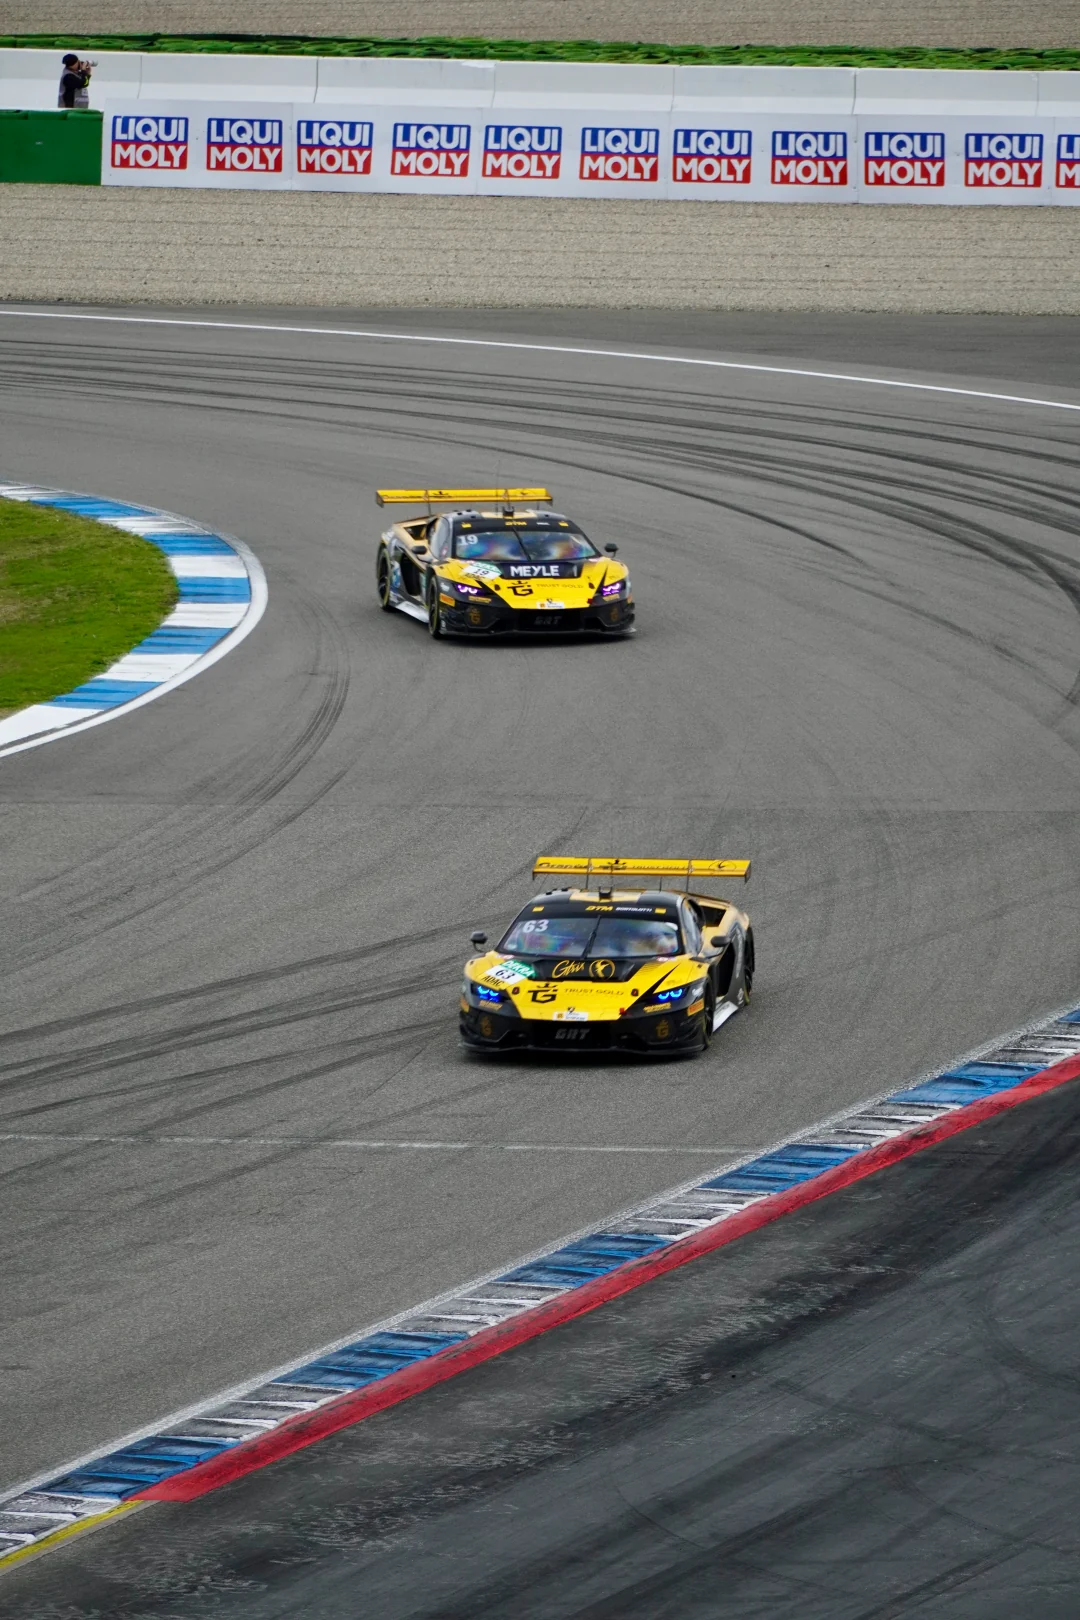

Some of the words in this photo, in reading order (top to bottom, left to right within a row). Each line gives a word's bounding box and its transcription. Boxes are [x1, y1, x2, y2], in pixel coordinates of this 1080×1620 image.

[115, 118, 185, 143] LIQUI
[210, 121, 280, 146] LIQUI
[300, 123, 371, 148] LIQUI
[396, 126, 468, 151] LIQUI
[487, 128, 560, 153] LIQUI
[584, 130, 657, 155] LIQUI
[115, 144, 187, 168] MOLY
[676, 132, 749, 157] LIQUI
[775, 134, 845, 159] LIQUI
[868, 135, 942, 159] LIQUI
[968, 136, 1041, 161] LIQUI
[210, 147, 281, 171] MOLY
[300, 149, 371, 172] MOLY
[394, 152, 468, 175] MOLY
[485, 154, 559, 177] MOLY
[582, 156, 657, 180] MOLY
[675, 158, 750, 182] MOLY
[774, 160, 847, 184] MOLY
[867, 161, 943, 184] MOLY
[967, 162, 1041, 186] MOLY
[459, 534, 478, 546] 19
[473, 568, 490, 576] 19
[510, 565, 560, 577] MEYLE
[523, 919, 548, 933] 63
[495, 969, 515, 980] 63
[502, 959, 536, 977] DEKRA
[482, 975, 505, 987] ADAC
